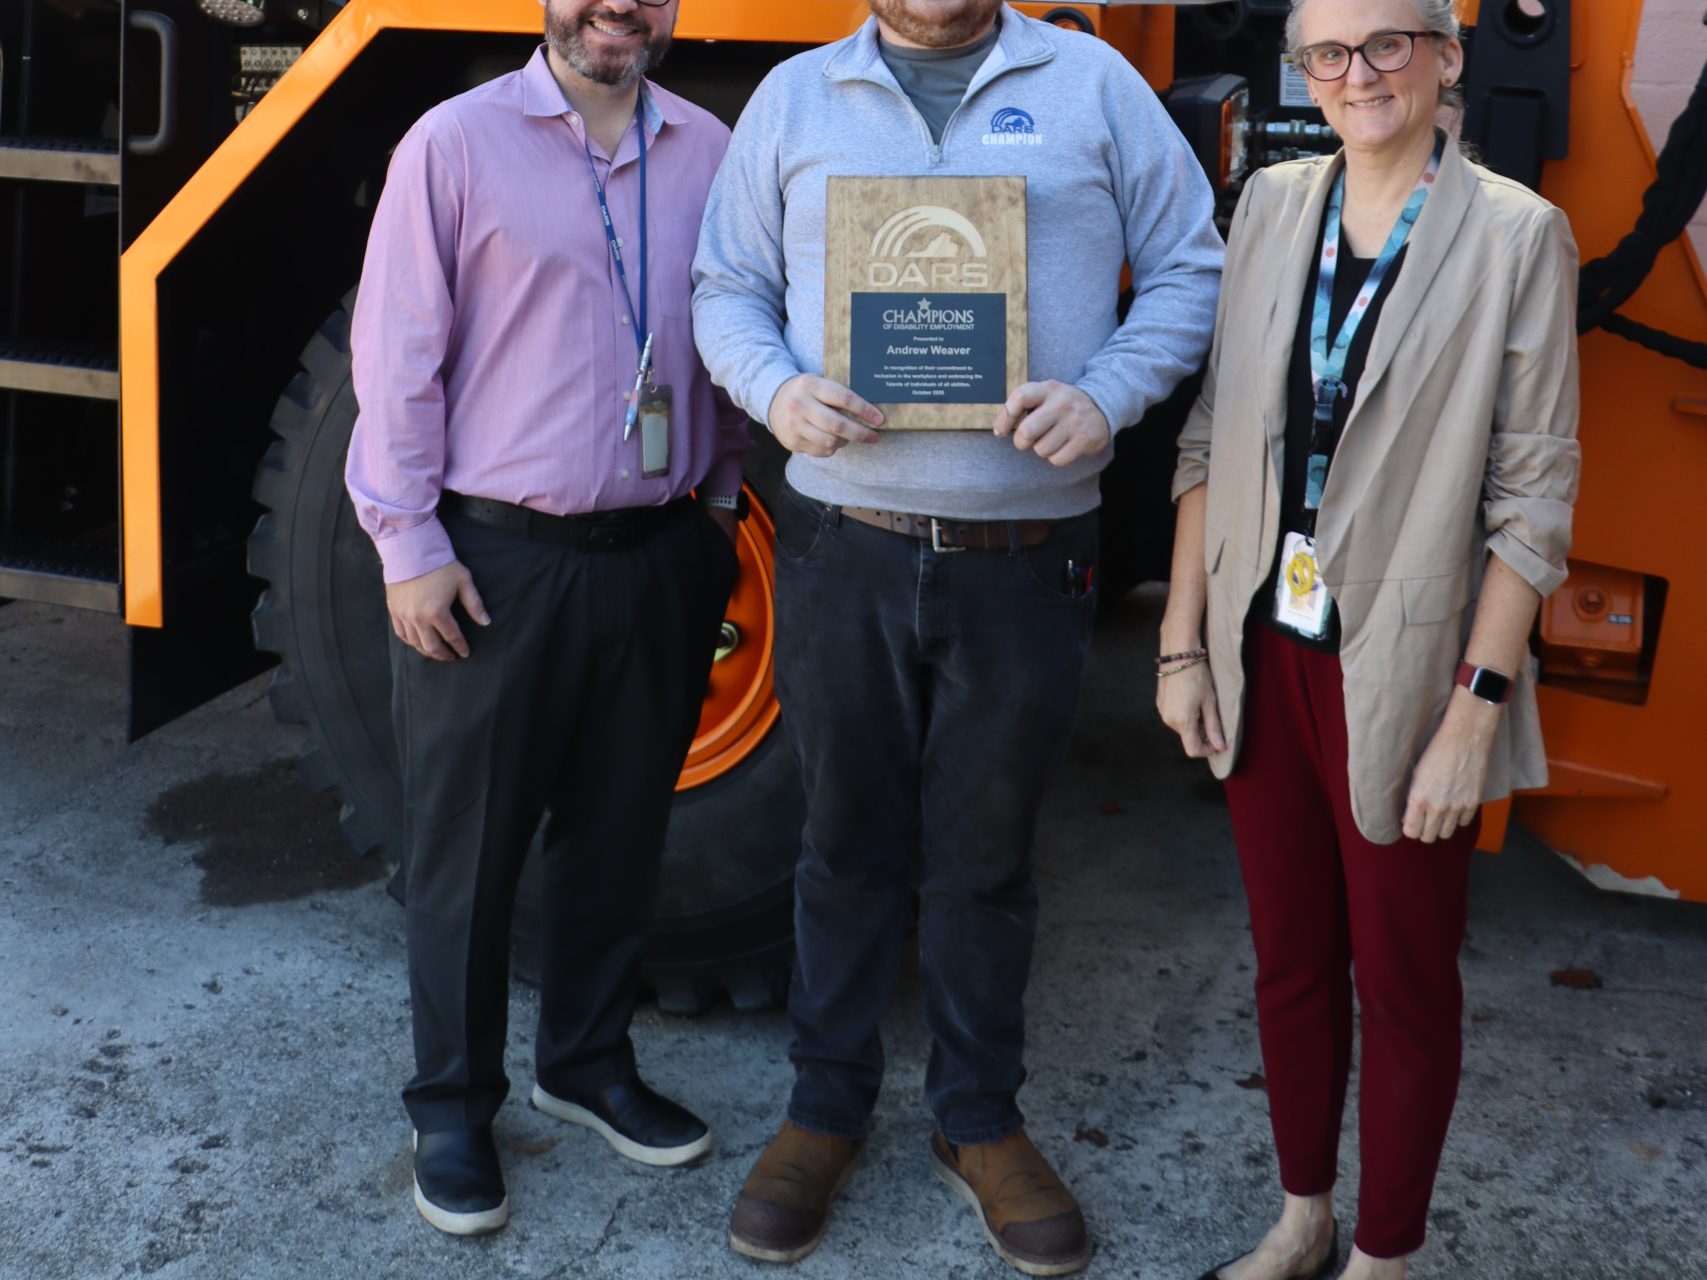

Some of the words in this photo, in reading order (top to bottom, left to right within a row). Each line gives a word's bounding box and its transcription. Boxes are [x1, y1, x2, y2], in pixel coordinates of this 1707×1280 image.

[991, 124, 1034, 134] DARS
[982, 133, 1043, 145] CHAMPION
[867, 261, 989, 288] DARS
[882, 309, 975, 324] CHAMPIONS
[929, 323, 975, 331] EMPLOYMENT
[886, 345, 928, 355] Andrew
[930, 345, 972, 355] Weaver
